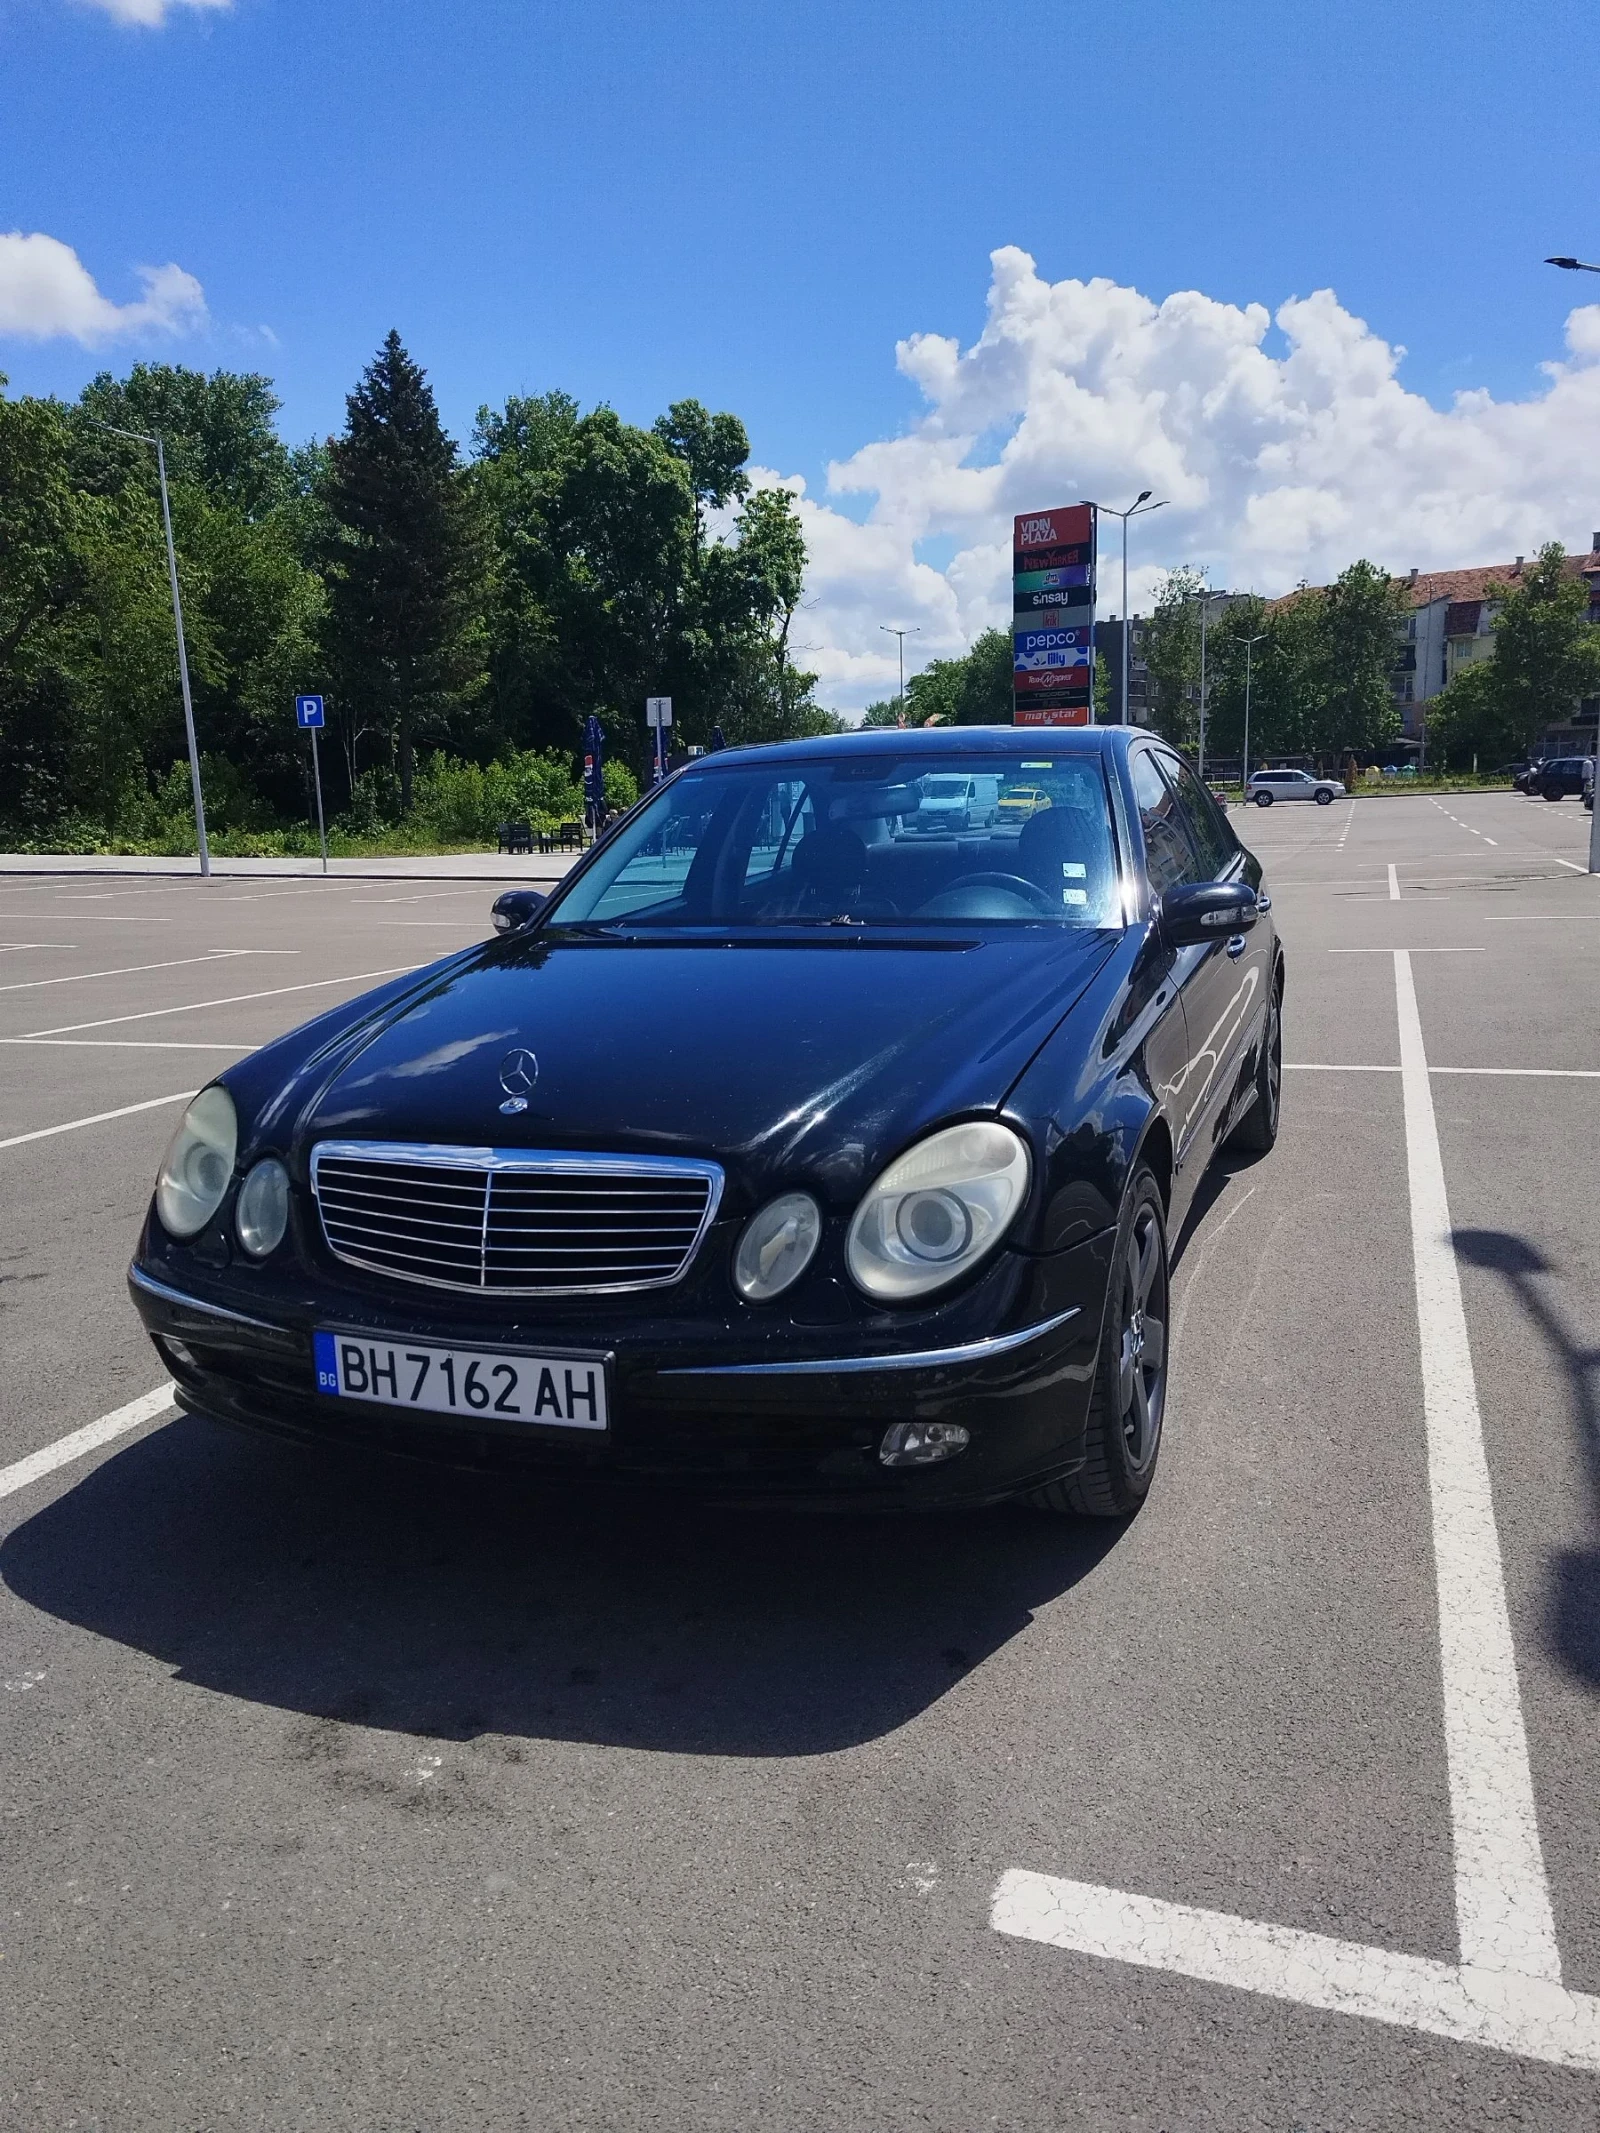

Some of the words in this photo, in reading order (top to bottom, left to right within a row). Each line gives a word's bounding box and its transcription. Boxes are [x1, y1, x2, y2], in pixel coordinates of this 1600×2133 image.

[1021, 518, 1051, 533] VIDIN
[1021, 529, 1057, 545] PLAZA
[1032, 592, 1068, 605] sinsay
[1026, 632, 1076, 650] pepco
[1047, 652, 1066, 666] lilly
[303, 701, 317, 723] P
[1051, 710, 1078, 719] star
[319, 1371, 336, 1388] BG
